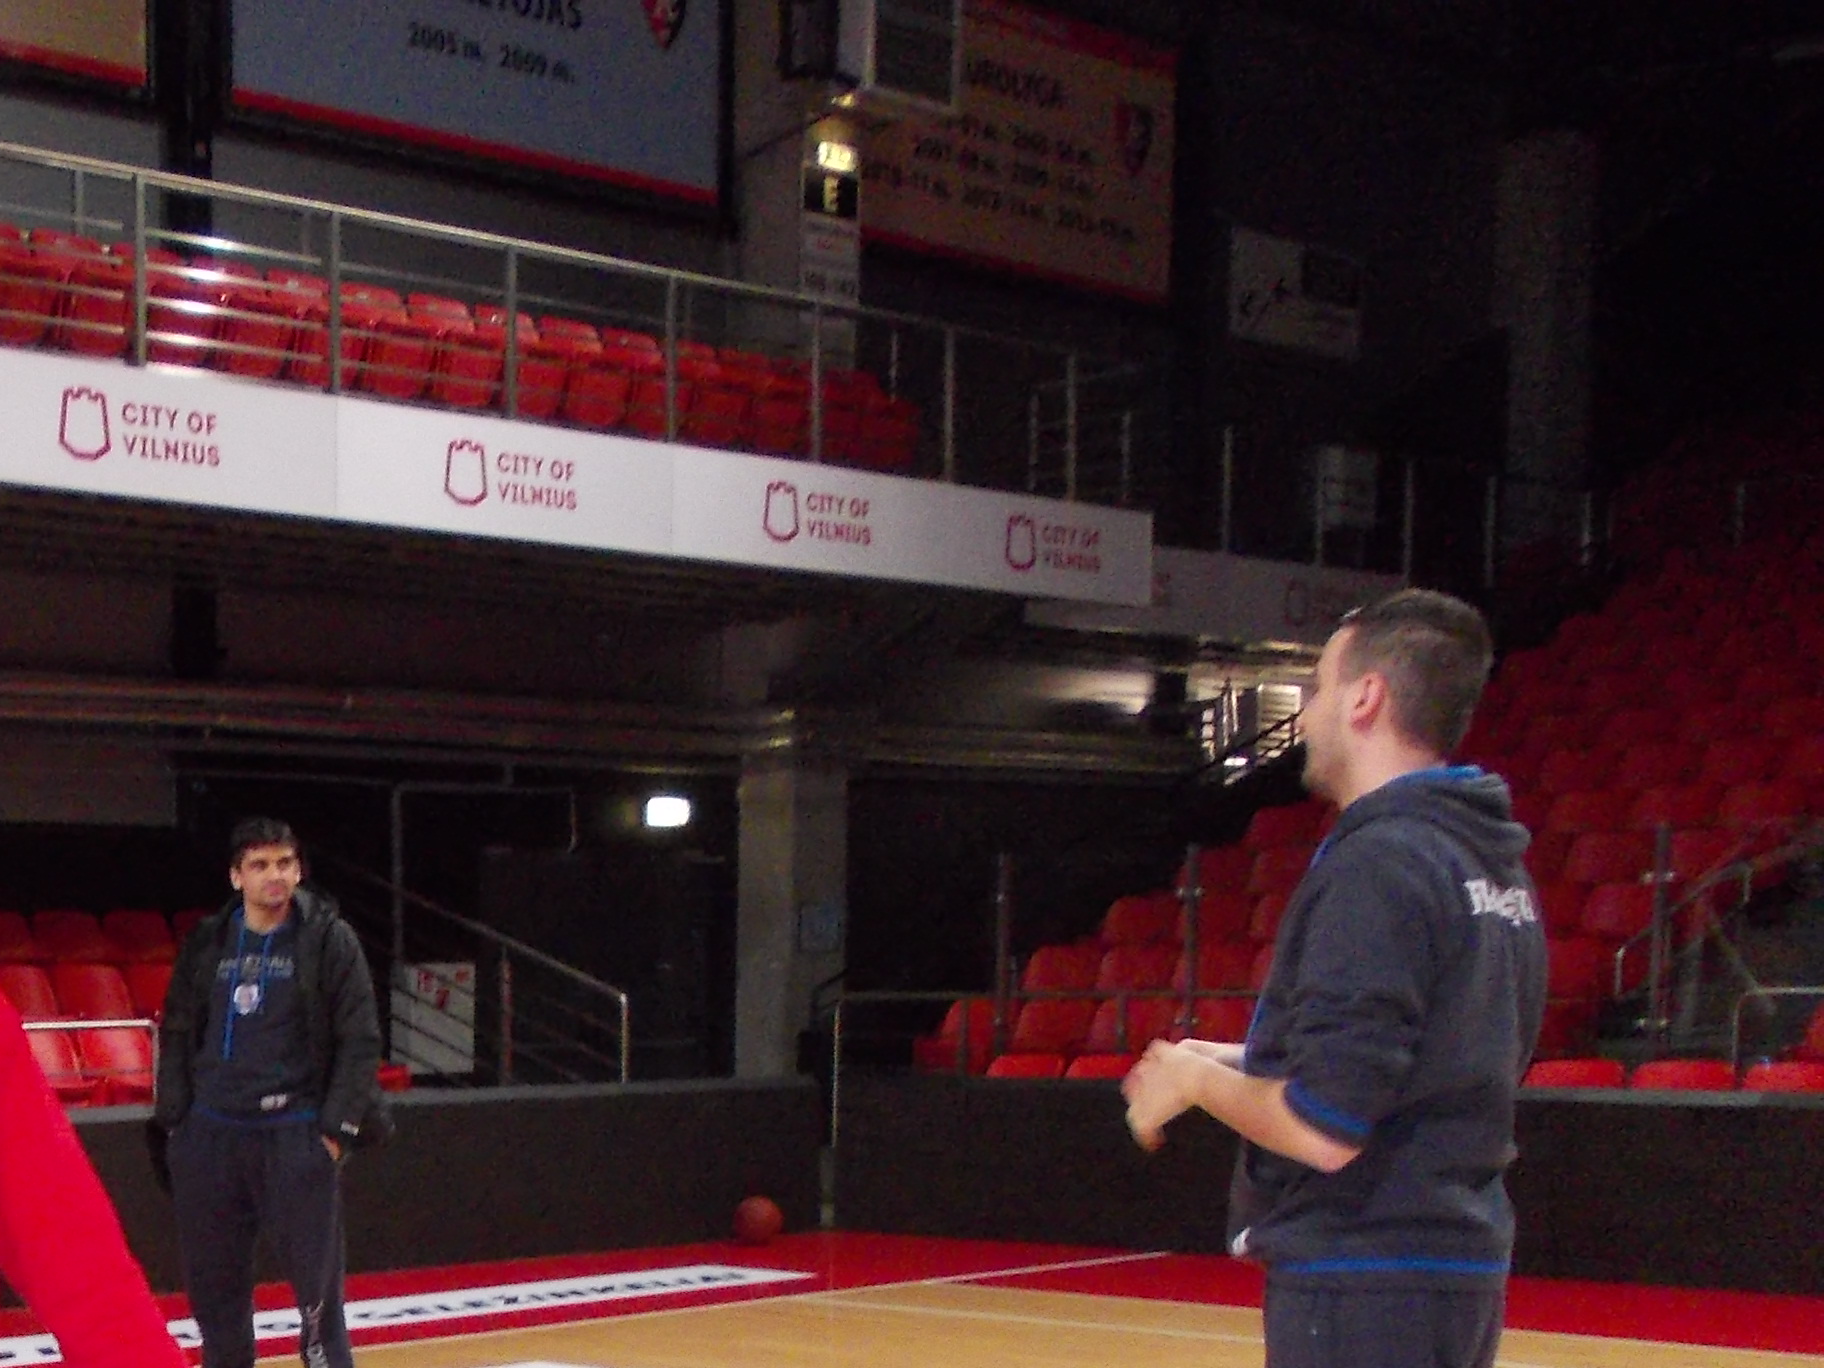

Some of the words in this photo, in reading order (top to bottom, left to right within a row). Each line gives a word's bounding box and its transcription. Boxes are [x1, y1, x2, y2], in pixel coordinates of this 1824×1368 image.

[121, 402, 179, 431] CITY
[187, 411, 217, 435] OF
[123, 433, 221, 468] VILNIUS
[496, 452, 544, 476] CITY
[551, 460, 574, 482] OF
[497, 481, 578, 511] VILNIUS
[806, 491, 845, 516] CITY
[850, 497, 870, 519] OF
[807, 517, 872, 546] VILNIUS
